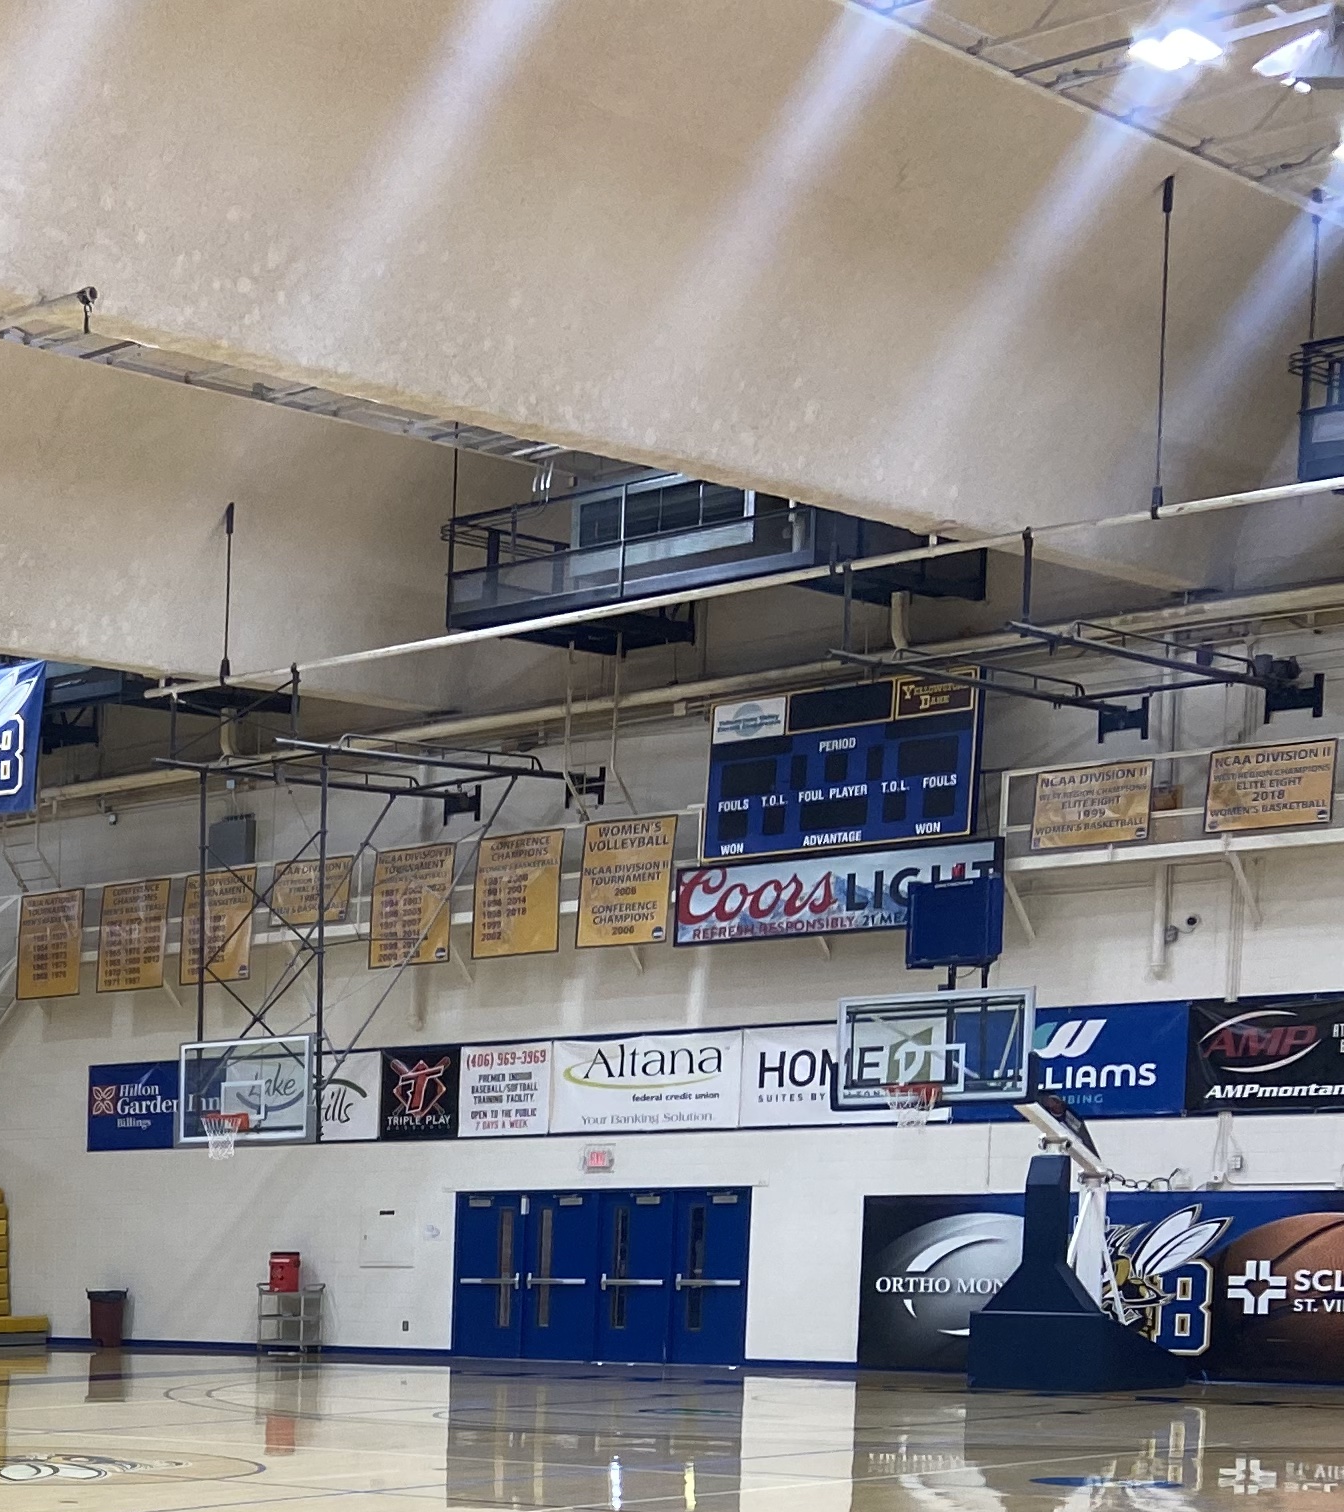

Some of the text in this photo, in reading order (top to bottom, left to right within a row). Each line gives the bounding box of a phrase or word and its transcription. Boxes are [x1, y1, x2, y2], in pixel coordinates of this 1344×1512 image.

[819, 737, 856, 752] PERIOD
[1215, 755, 1251, 768] NCAA
[1256, 749, 1318, 764] DIVISION
[1040, 776, 1076, 788] NCAA
[1079, 768, 1136, 785] DIVISION
[1236, 777, 1302, 790] ELITE EIGHT
[718, 774, 957, 812] FOULS T.O.L. FOUL PLAYER T.O.L. FOULS
[1252, 790, 1286, 802] 2018
[1061, 799, 1089, 810] ELITE
[1210, 799, 1327, 817] WOMEN'S BASKETBALL
[598, 821, 662, 838] WOMEN'S
[1035, 817, 1144, 836] WOMEN'S BASKETBALL
[490, 835, 551, 852] CONFERENCE
[588, 834, 669, 853] VOLLEYBALL
[720, 822, 941, 856] WON ADVANTAGE WON
[491, 846, 548, 862] CHAMPIONS
[584, 865, 612, 877] NCAA
[617, 861, 659, 873] DIVISION
[590, 871, 662, 886] TOURNAMENT
[677, 866, 839, 925] Coors
[591, 900, 658, 915] CONFERENCE
[592, 911, 655, 926] CHAMPIONS
[692, 926, 754, 940] REFRESH
[1203, 1025, 1317, 1058] AMP
[467, 1051, 494, 1070] (406)
[583, 1044, 723, 1079] Altana
[478, 1073, 505, 1083] PREMIER
[119, 1084, 160, 1097] Hilton
[471, 1083, 538, 1095] BASEBALL/SOFTBALL
[632, 1093, 663, 1102] federal
[665, 1092, 692, 1101] credit
[758, 1092, 826, 1103] SUITES BY
[387, 1114, 450, 1126] TRIPLE PLAY
[471, 1110, 487, 1119] OPEN
[501, 1108, 512, 1118] THE
[515, 1108, 537, 1118] PUBLIC
[581, 1115, 607, 1125] Your
[611, 1113, 660, 1125] Banking
[117, 1118, 152, 1130] Billings
[482, 1121, 499, 1130] DAYS
[509, 1119, 528, 1128] WEEK
[875, 1276, 951, 1293] ORTHO
[1293, 1299, 1318, 1312] ST.
